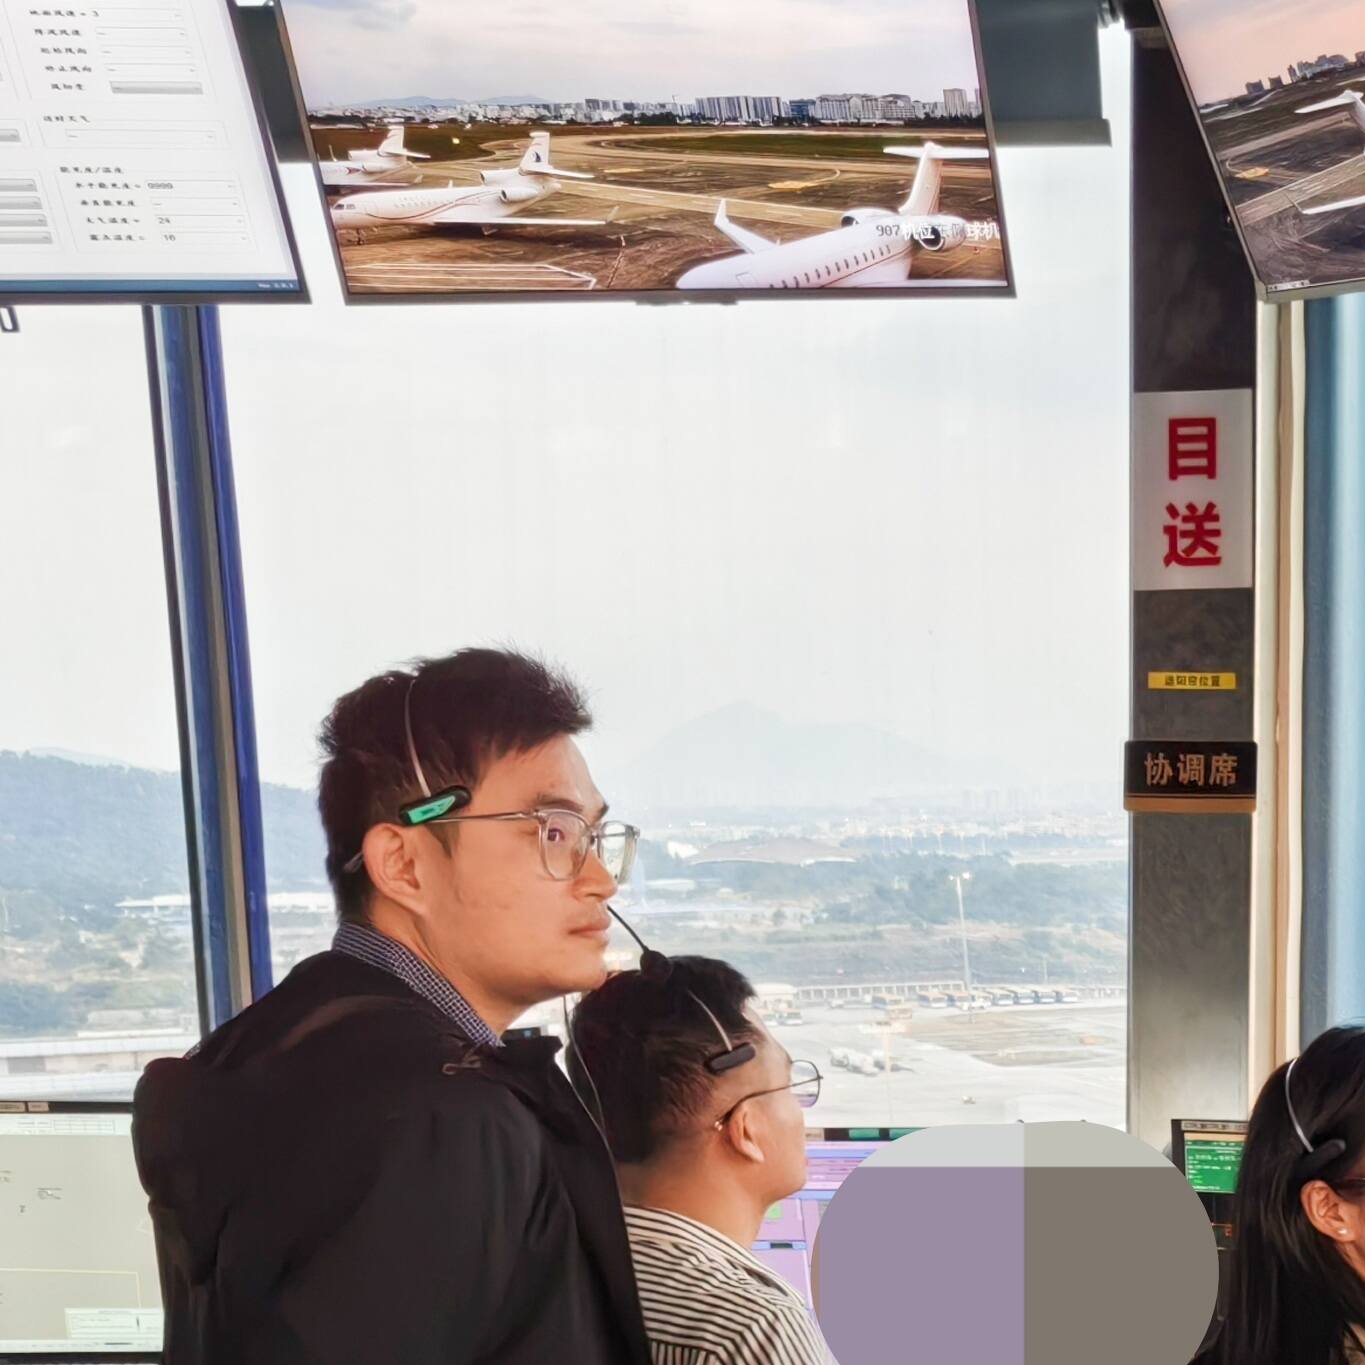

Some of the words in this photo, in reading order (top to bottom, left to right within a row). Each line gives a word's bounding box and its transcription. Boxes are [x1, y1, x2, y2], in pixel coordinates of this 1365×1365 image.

[1163, 416, 1223, 567] 目送
[1144, 752, 1239, 787] 协调席
